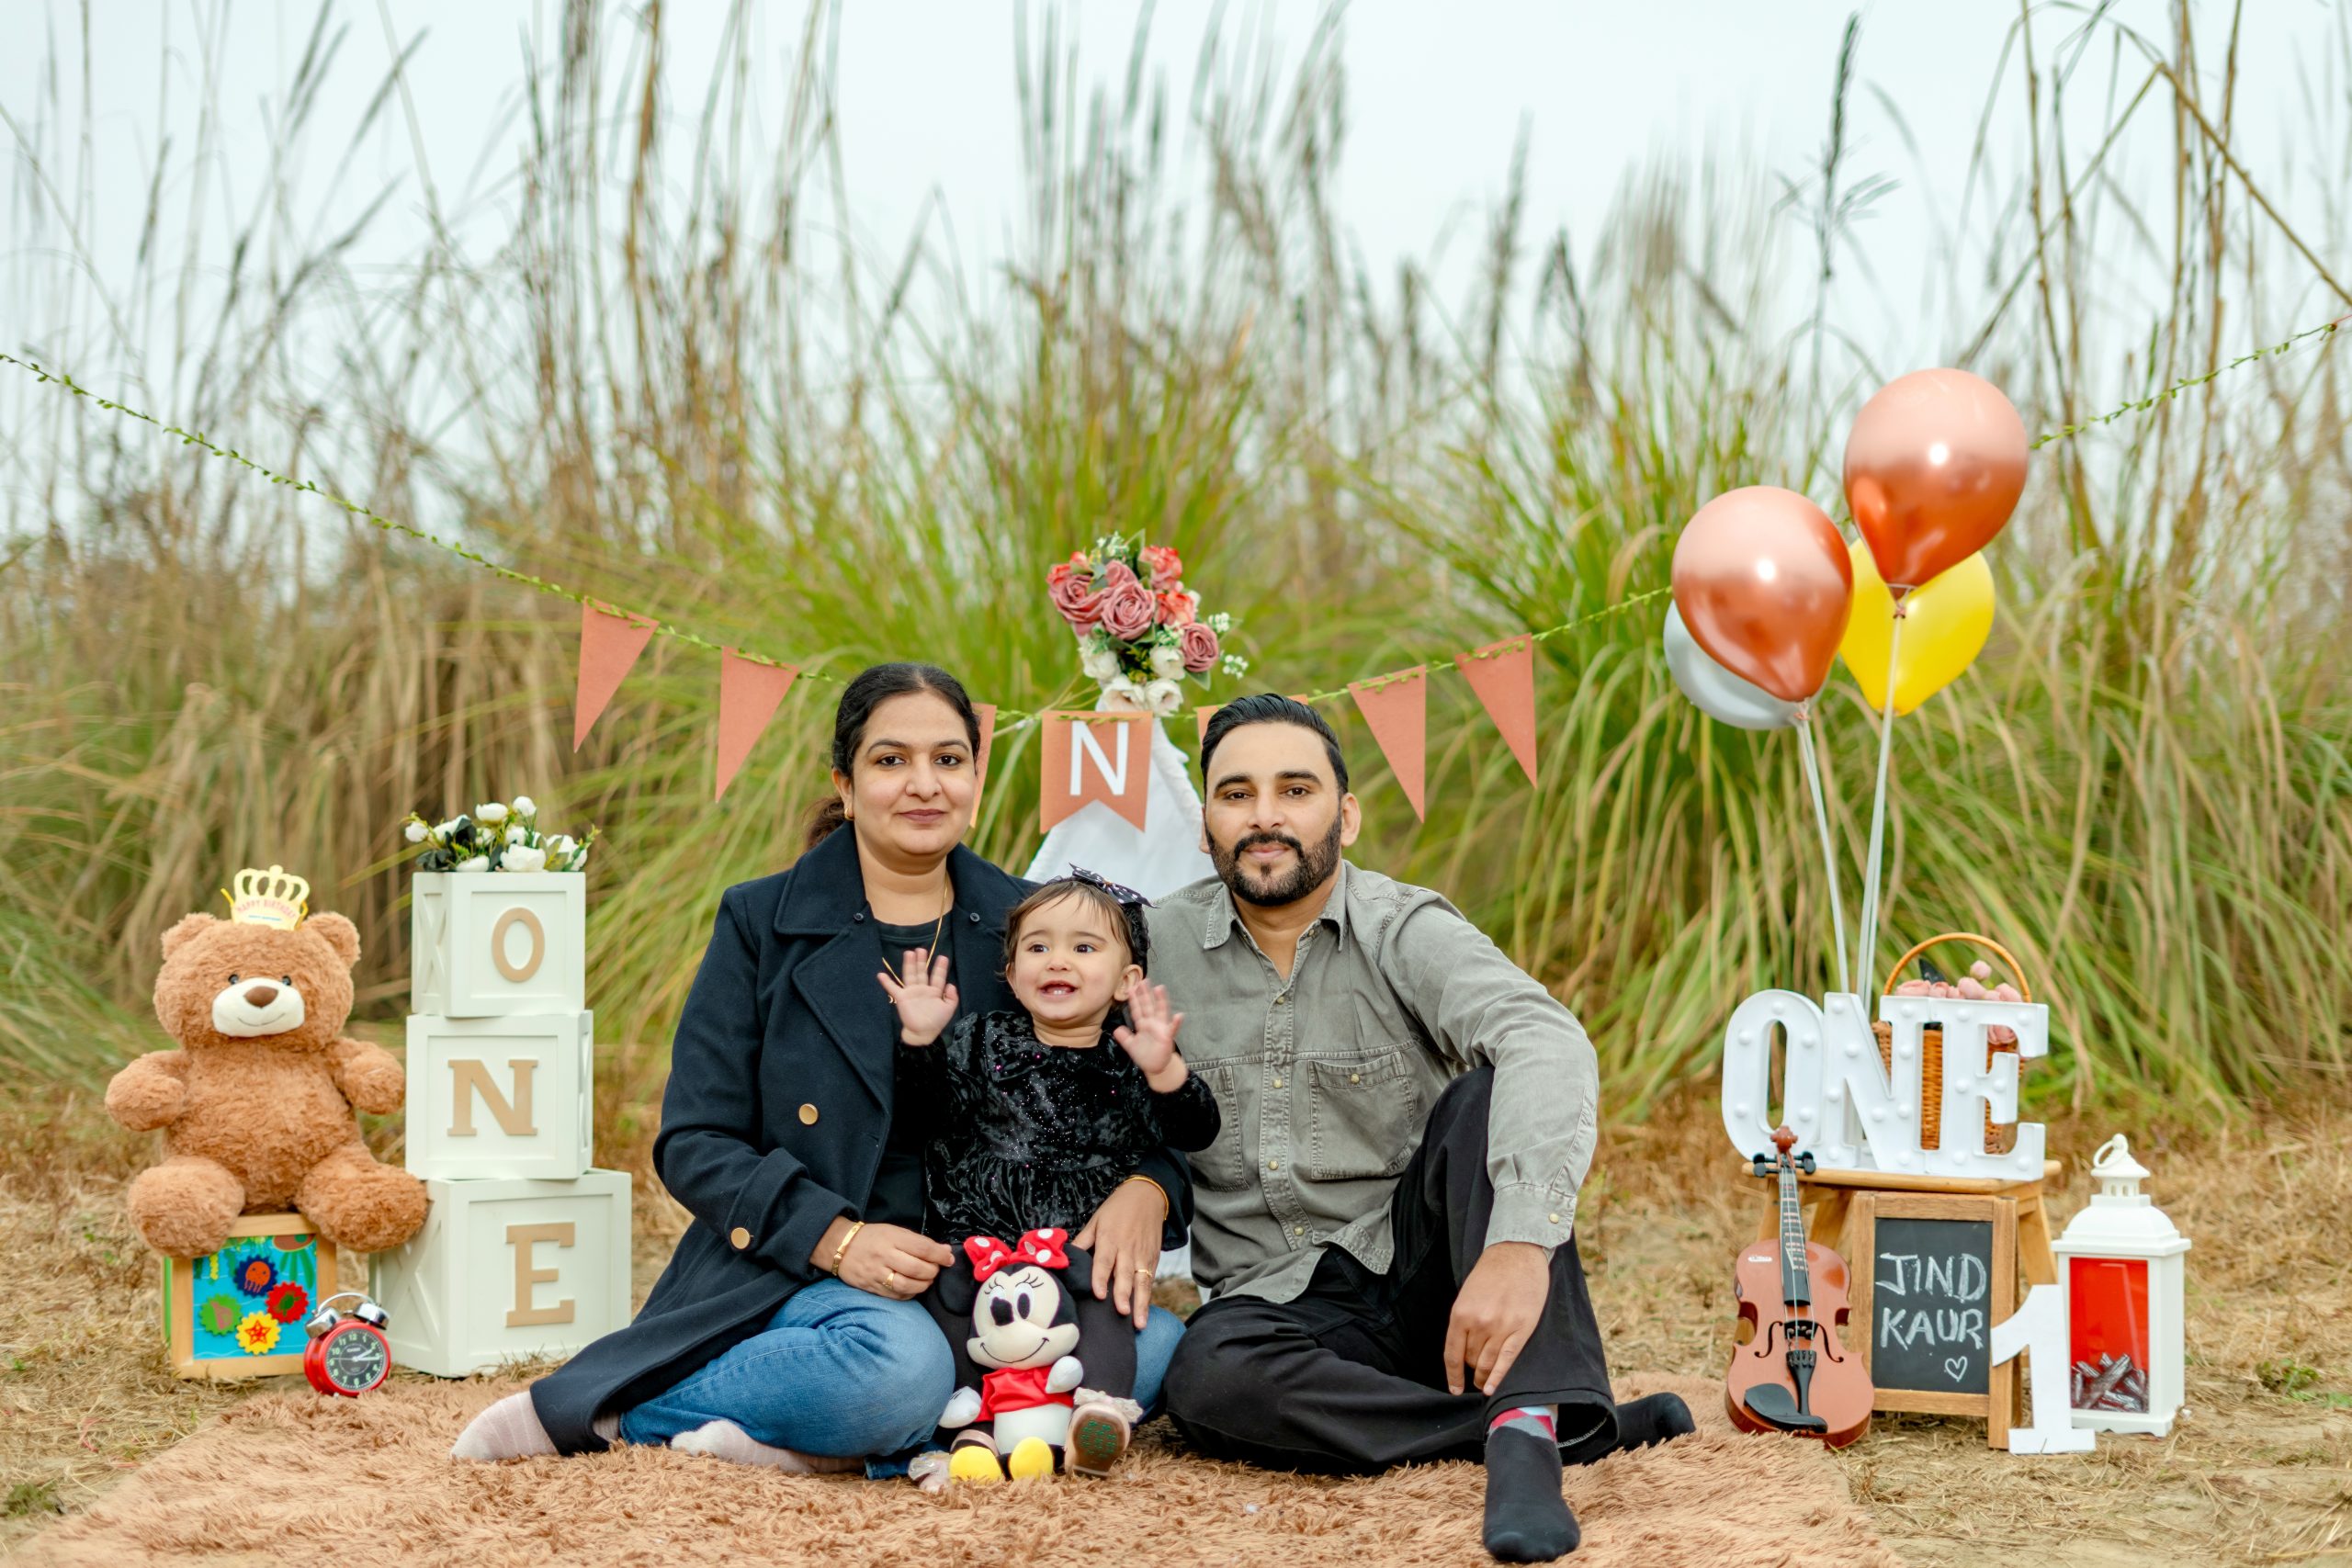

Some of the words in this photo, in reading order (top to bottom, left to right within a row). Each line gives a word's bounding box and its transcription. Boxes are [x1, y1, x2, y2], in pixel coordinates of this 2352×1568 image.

[1069, 719, 1129, 796] N
[1721, 988, 2049, 1182] ONE
[1874, 1253, 1987, 1303] JIND
[1880, 1307, 1984, 1351] KAUR
[1990, 1284, 2096, 1455] 1
